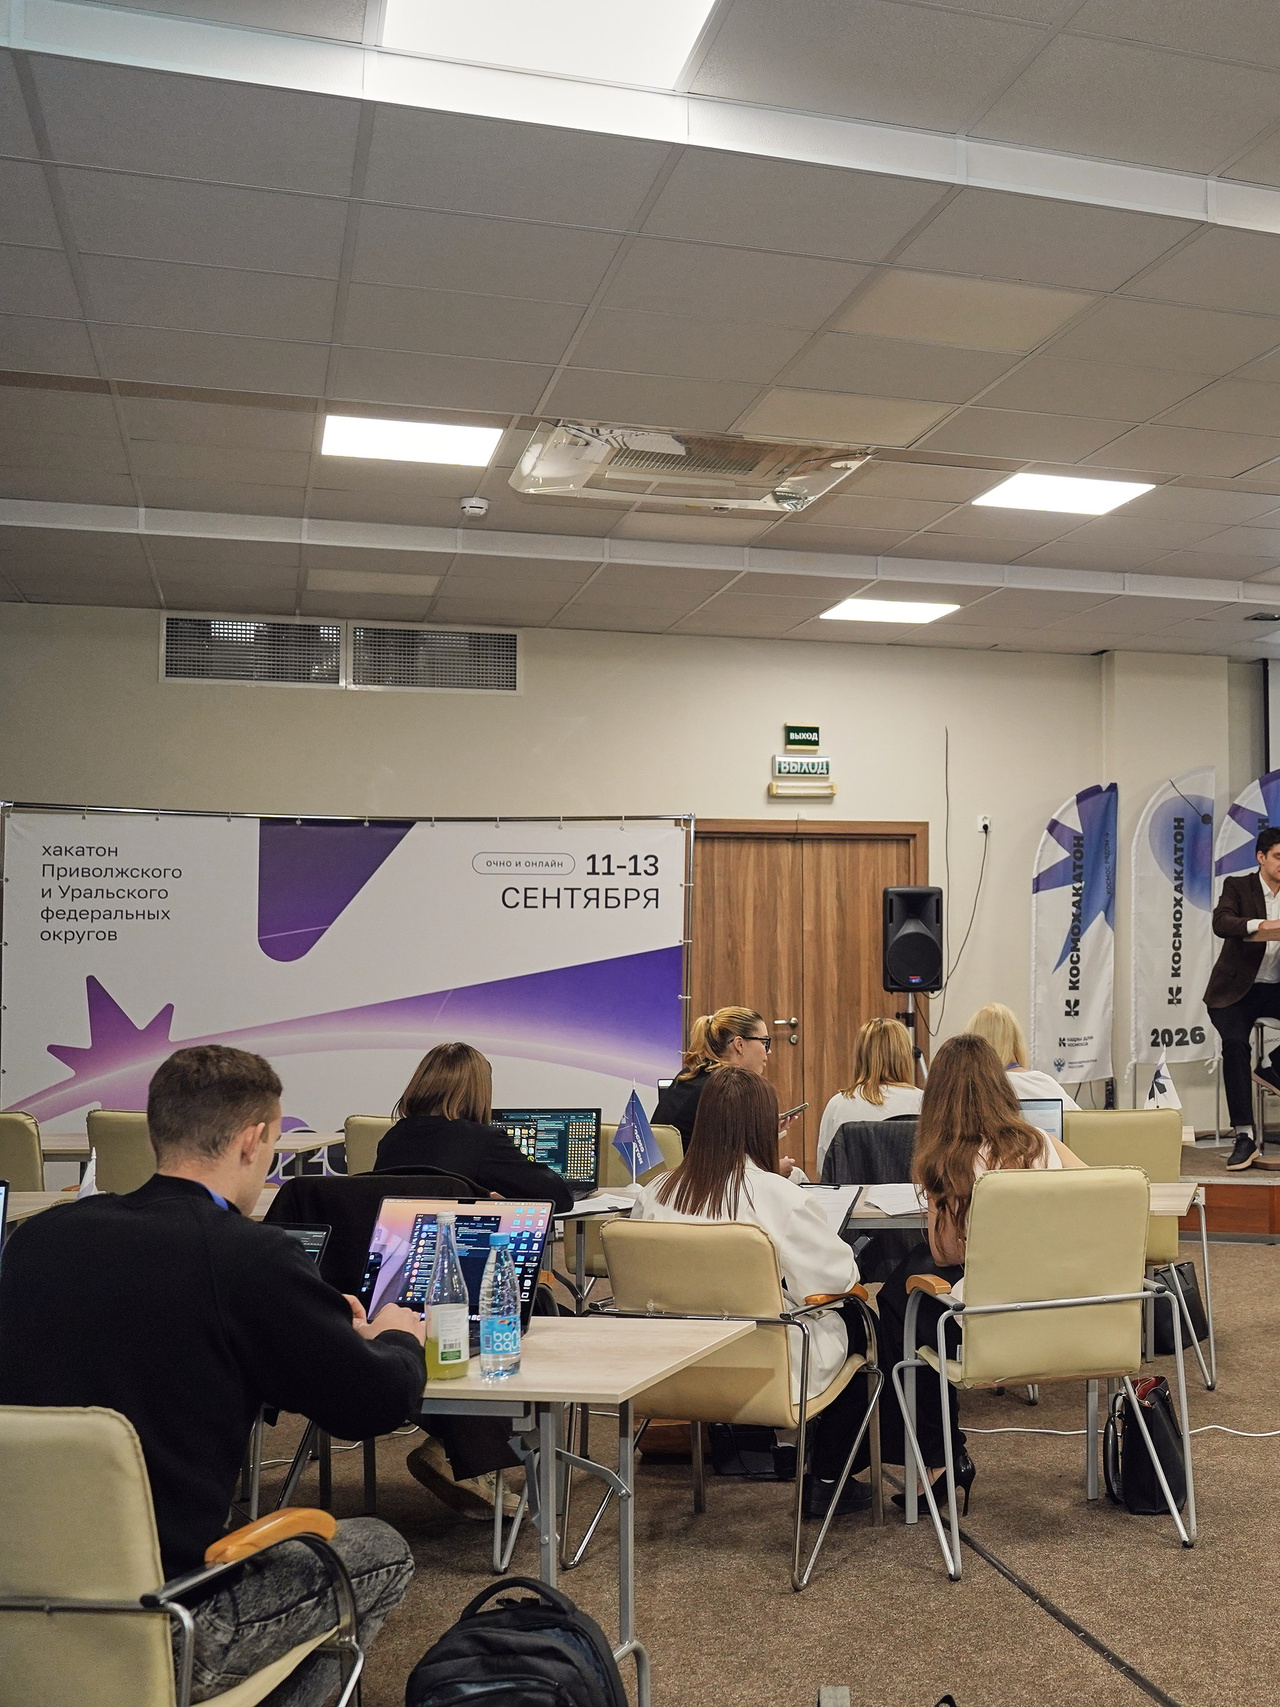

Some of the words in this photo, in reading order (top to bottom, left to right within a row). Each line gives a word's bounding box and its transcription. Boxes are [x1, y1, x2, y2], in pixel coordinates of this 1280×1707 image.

[790, 732, 818, 741] ВЫХОД
[781, 760, 827, 774] ВЫХОД
[41, 845, 118, 857] хакатон
[486, 860, 512, 868] ОЧНО
[515, 860, 521, 868] И
[524, 858, 564, 868] ОНЛАЙН
[586, 854, 660, 876] 11-13
[41, 863, 183, 881] Приволжского
[41, 887, 52, 899] и
[58, 885, 169, 902] Уральского
[501, 886, 660, 909] СЕНТЯБРЯ
[1171, 817, 1185, 978] КОСМОХАКАТОН
[40, 906, 171, 923] федеральных
[1069, 835, 1085, 991] КОСМОХАКАТОН
[40, 930, 118, 944] округов
[1151, 1027, 1205, 1047] 2026
[494, 1341, 520, 1352] aqu
